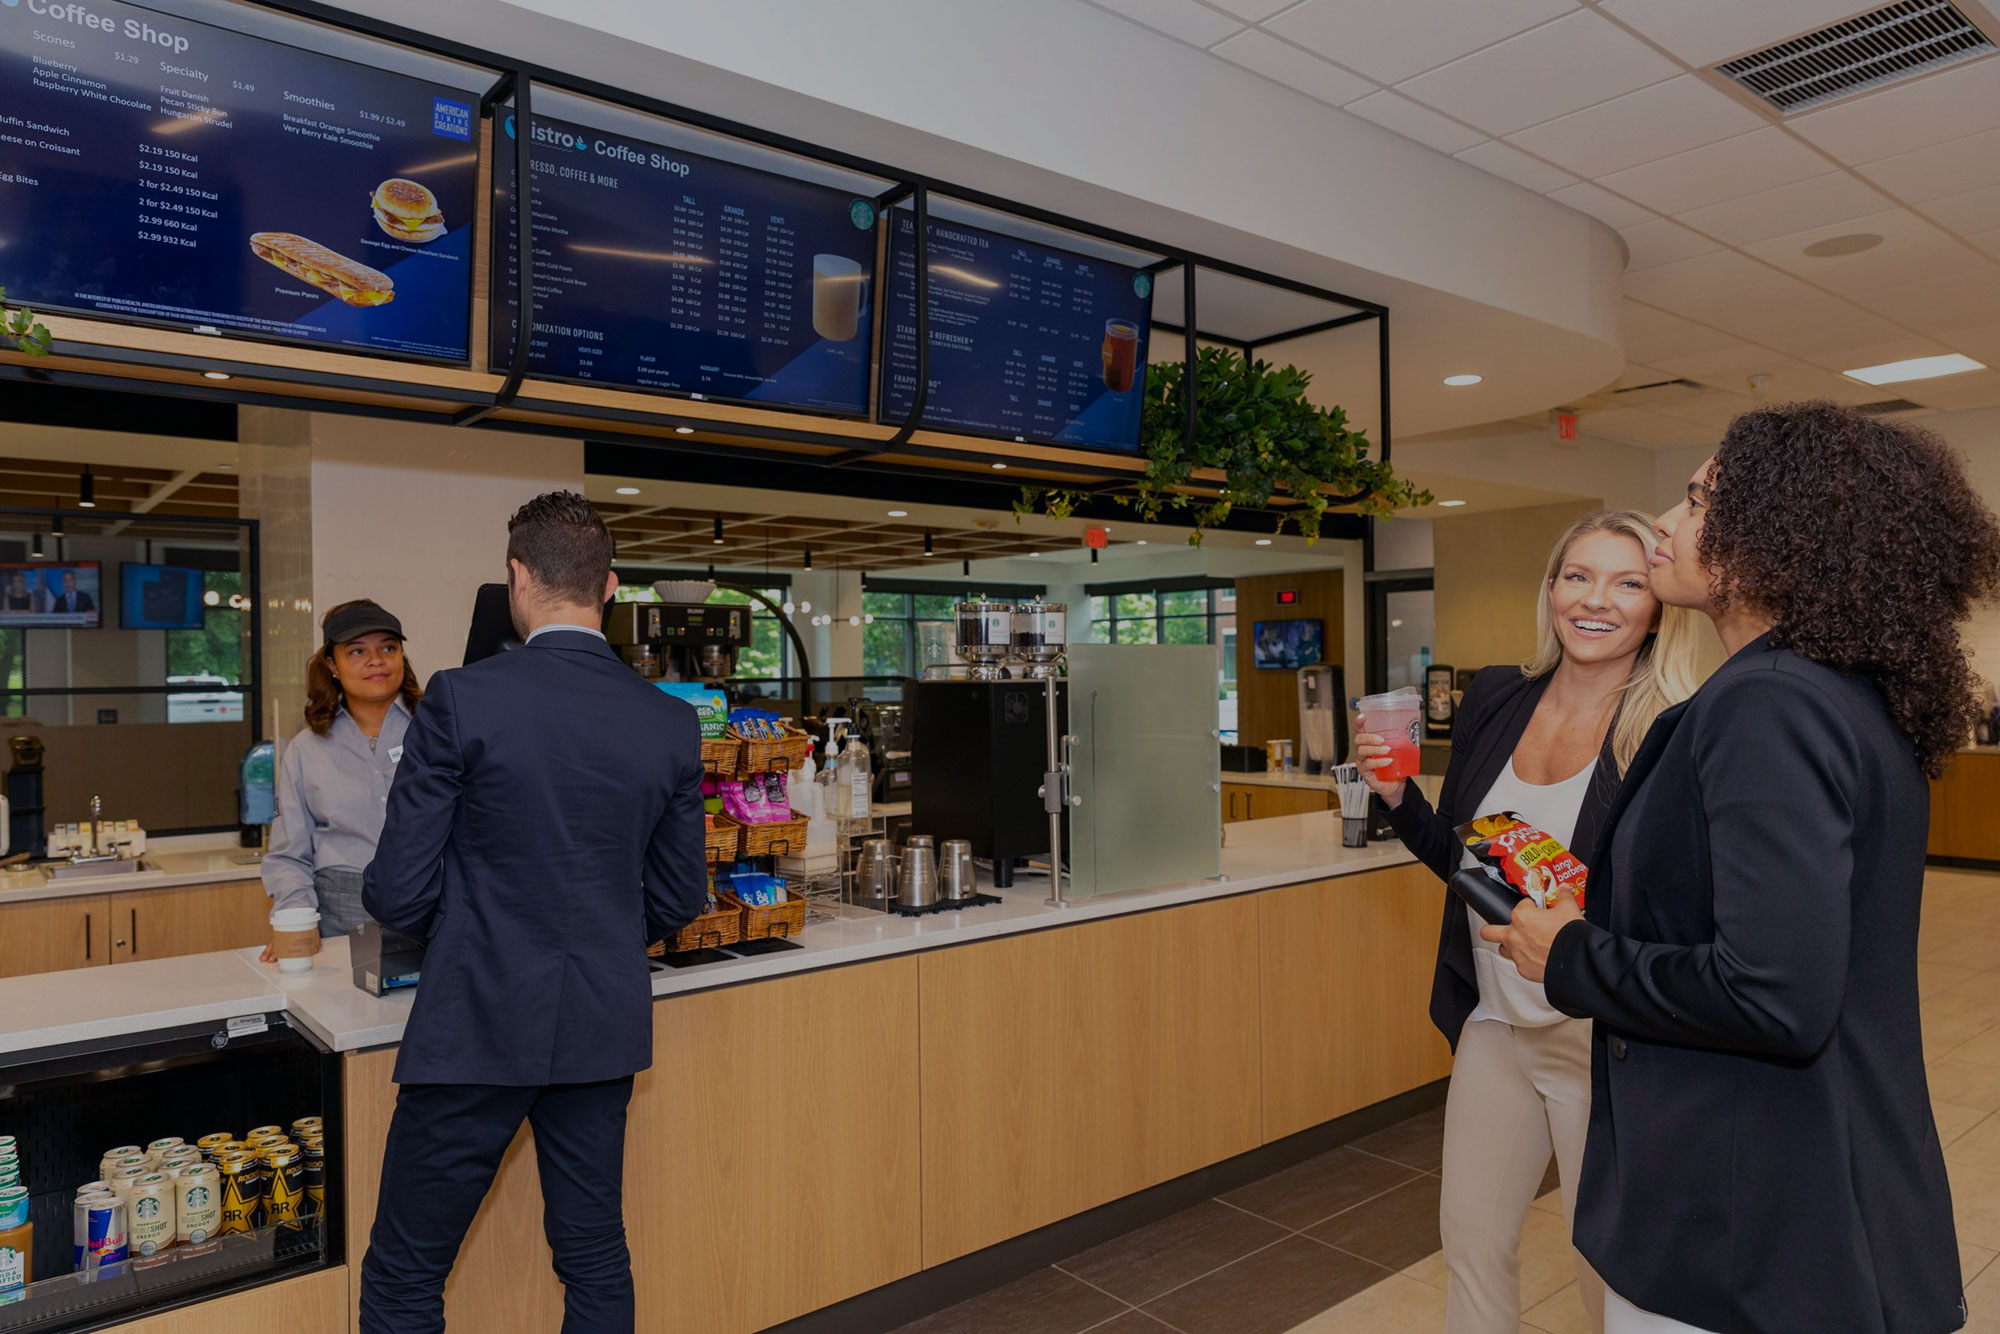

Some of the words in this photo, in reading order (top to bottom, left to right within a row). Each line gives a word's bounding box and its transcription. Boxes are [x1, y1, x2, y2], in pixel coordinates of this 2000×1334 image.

[28, 0, 116, 33] Coffee
[123, 19, 189, 54] Shop
[33, 30, 76, 49] Scones
[114, 52, 139, 64] $1.29
[33, 55, 77, 73] Blueberry
[33, 67, 60, 80] Apple
[61, 73, 107, 91] Cinnamon
[160, 62, 209, 82] Specialty
[232, 80, 255, 93] $1.49
[33, 78, 79, 96] Raspberry
[81, 88, 108, 102] White
[109, 95, 152, 111] Chocolate
[160, 85, 180, 96] Fruit
[182, 90, 209, 103] Danish
[160, 96, 185, 108] Pecan
[187, 101, 210, 115] Sticky
[212, 107, 228, 118] Bun
[283, 90, 336, 112] Smoothies
[360, 110, 381, 123] $1.99
[386, 116, 406, 128] $2.49
[434, 102, 469, 119] AMERICAN
[160, 107, 203, 123] Hungarian
[204, 116, 233, 129] Strudel
[283, 112, 318, 129] Breakfast
[319, 121, 346, 135] Orange
[346, 127, 381, 142] Smoothie
[26, 120, 70, 137] Sandwich
[282, 123, 300, 136] Very
[301, 128, 321, 141] Berry
[322, 132, 339, 144] Kale
[339, 135, 374, 151] Smoothie
[434, 120, 469, 136] CREATIONS
[1, 134, 23, 145] eese
[25, 139, 37, 148] on
[39, 140, 81, 156] Croissant
[138, 143, 163, 156] $2.19
[164, 149, 181, 160] 150
[181, 152, 198, 163] Kcal
[594, 140, 647, 166] Coffee
[650, 153, 690, 178] Shop
[138, 160, 163, 172] $2.19
[164, 165, 181, 176] 150
[181, 169, 198, 179] Kcal
[559, 165, 588, 182] COFFEE
[589, 172, 596, 184] &
[597, 174, 619, 189] MORE
[16, 174, 39, 186] Bites
[138, 178, 145, 188] 2
[146, 180, 159, 190] for
[160, 182, 184, 194] $2.49
[185, 187, 201, 198] 150
[202, 190, 219, 201] Kcal
[138, 197, 145, 206] 2
[146, 198, 159, 208] for
[160, 201, 184, 213] $2.49
[185, 206, 201, 216] 150
[201, 209, 219, 219] Kcal
[682, 195, 696, 206] TALL
[723, 204, 745, 217] GRANDE
[138, 214, 163, 226] $2.99
[163, 219, 180, 229] 660
[181, 222, 198, 232] Kcal
[532, 224, 551, 233] ocolate
[137, 230, 162, 242] $2.99
[162, 235, 179, 245] 932
[180, 238, 197, 248] Kcal
[935, 228, 978, 247] HANDCRAFTED
[978, 238, 990, 249] TEA
[275, 287, 301, 298] Premium
[300, 291, 319, 300] Panini
[572, 328, 604, 342] OPTIONS
[934, 331, 969, 345] REFRESHER
[701, 722, 725, 732] ANIC
[1520, 846, 1541, 866] BOLD
[186, 1220, 211, 1229] ENERGY
[104, 1232, 124, 1247] Bull
[136, 1231, 161, 1240] ENERGY
[0, 1274, 22, 1285] AFTED
